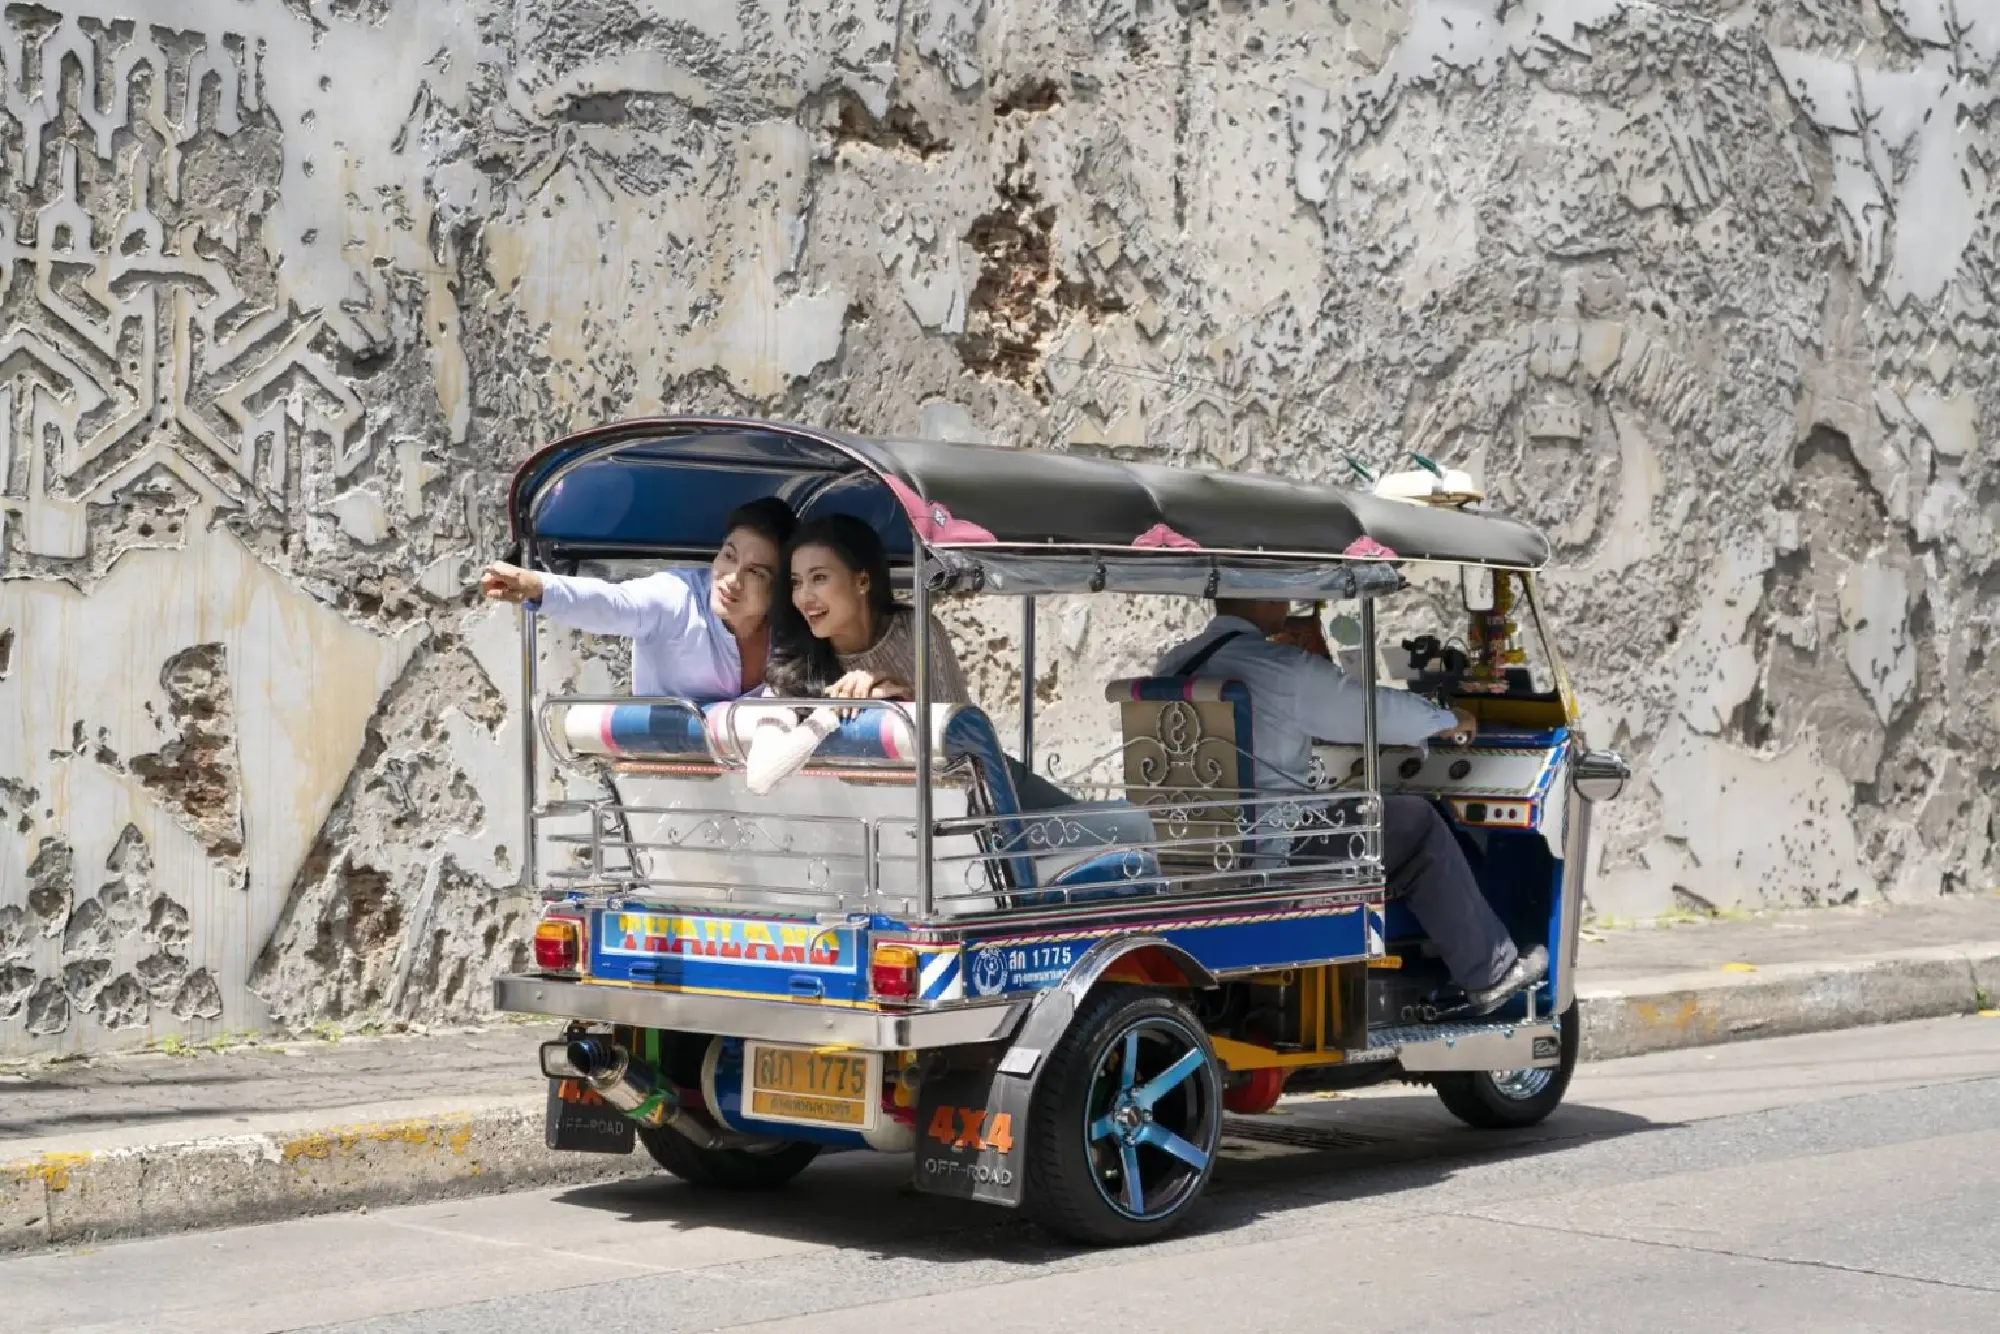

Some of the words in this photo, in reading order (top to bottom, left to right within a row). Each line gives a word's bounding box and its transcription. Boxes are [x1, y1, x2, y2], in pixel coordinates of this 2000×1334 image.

[619, 913, 840, 965] THAILAND
[1032, 947, 1071, 968] 1775
[807, 1052, 866, 1094] 1775
[925, 1158, 1012, 1185] OFF-ROAD
